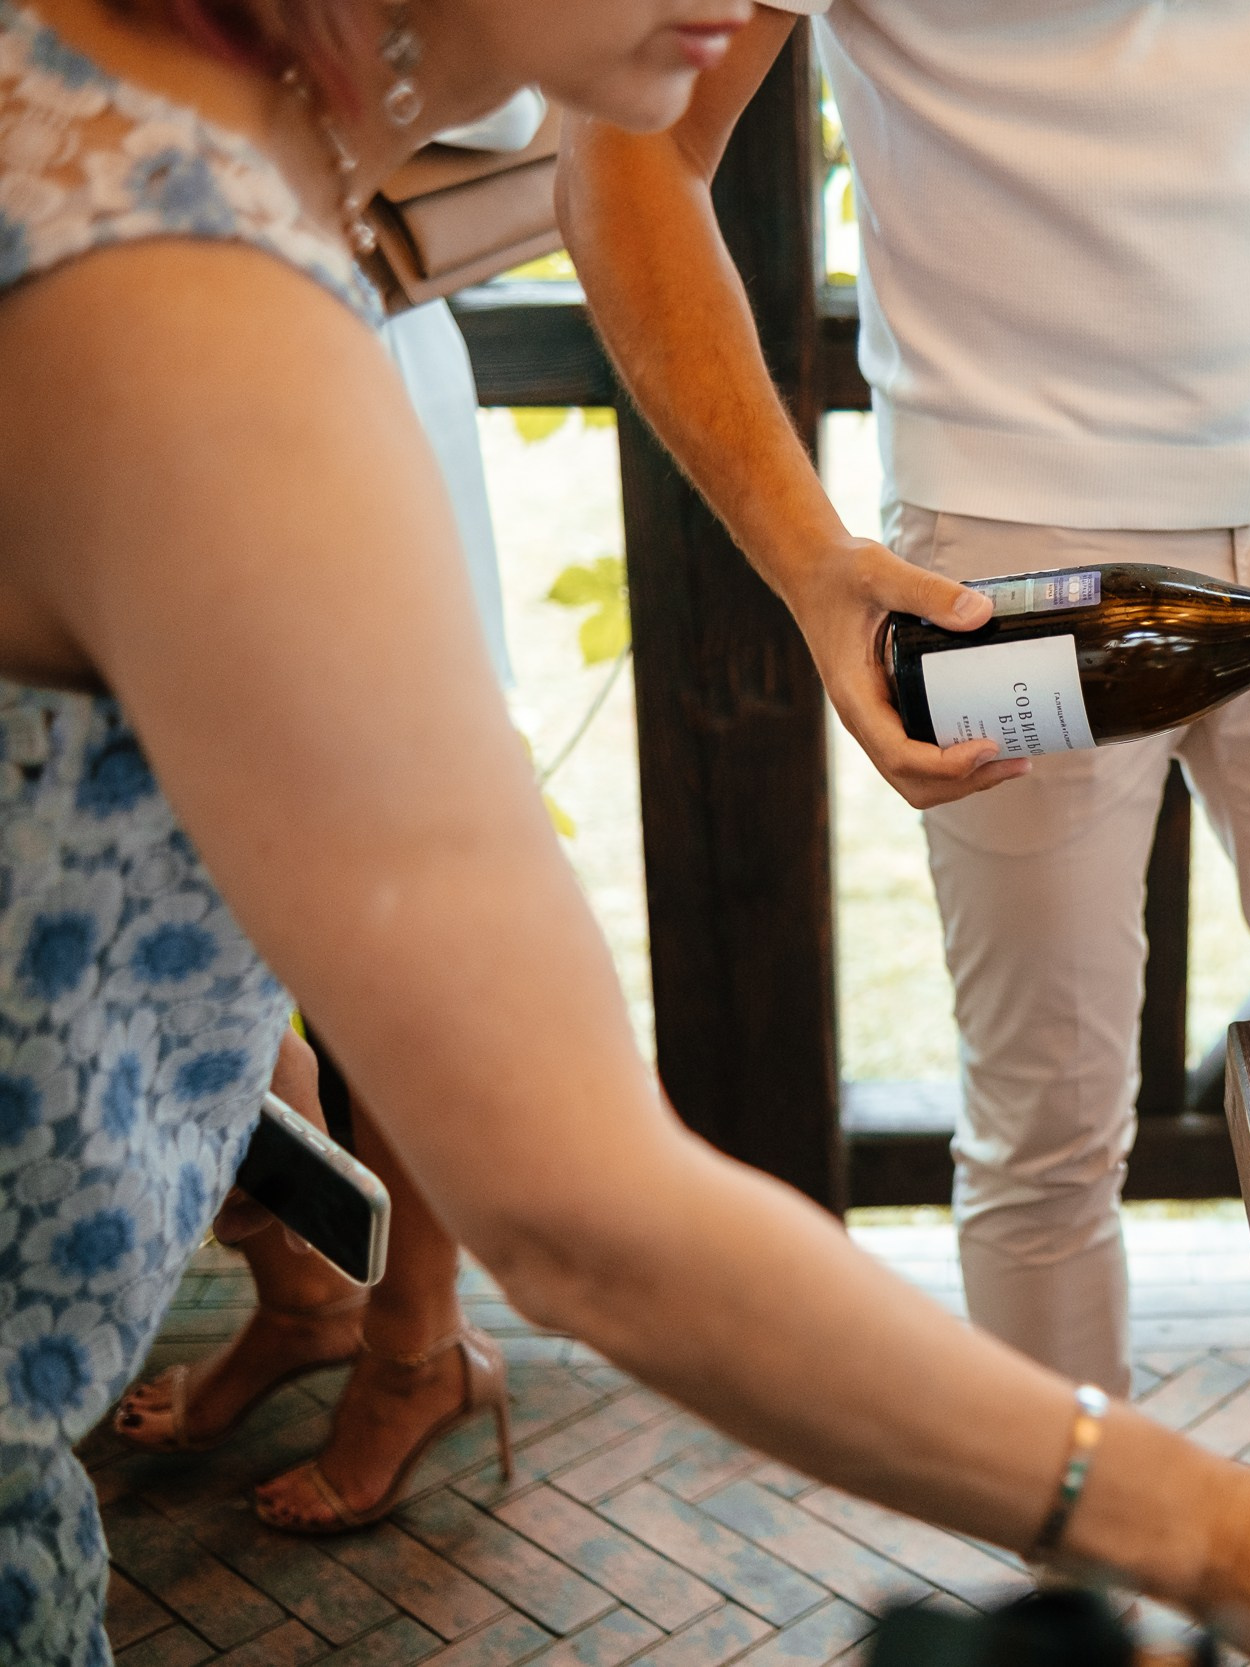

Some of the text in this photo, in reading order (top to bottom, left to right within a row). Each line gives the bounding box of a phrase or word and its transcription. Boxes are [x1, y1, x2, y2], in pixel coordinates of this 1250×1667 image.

[962, 715, 973, 741] КРАСНА
[1054, 692, 1067, 728] ГАЛИЦКИЙ
[998, 714, 1022, 752] БЛАН
